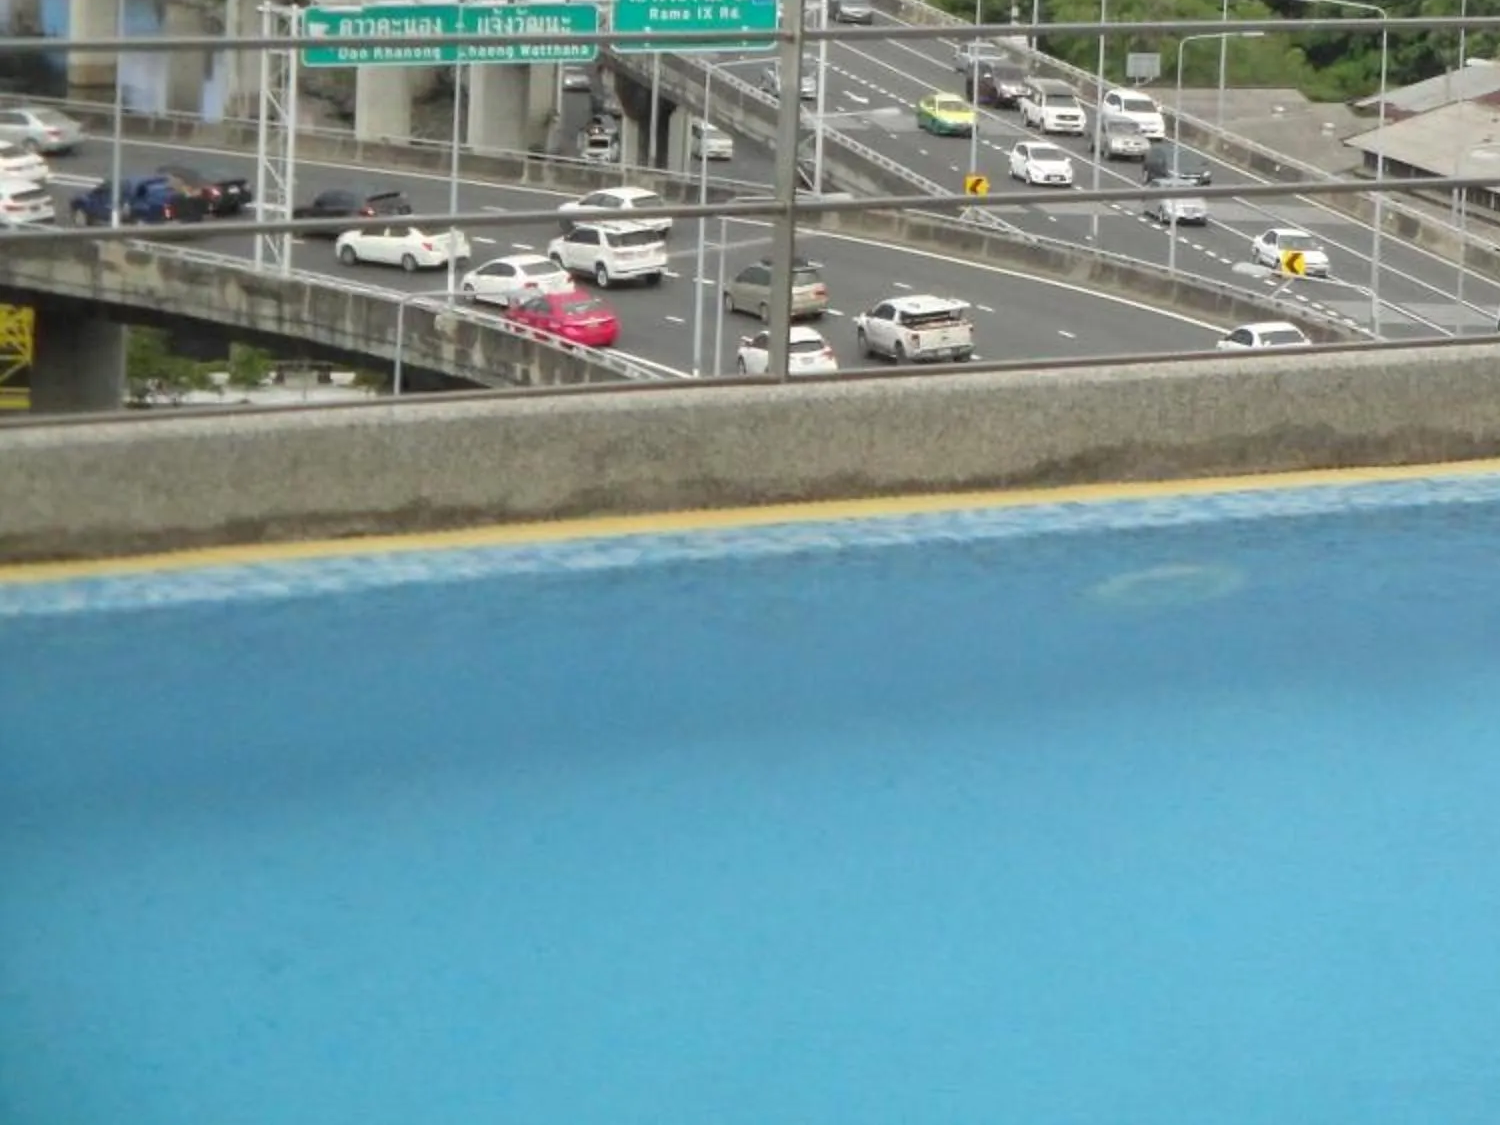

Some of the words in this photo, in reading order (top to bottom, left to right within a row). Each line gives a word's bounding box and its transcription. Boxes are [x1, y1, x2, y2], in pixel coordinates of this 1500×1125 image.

[650, 8, 691, 21] Rama
[697, 8, 713, 20] IX
[337, 46, 368, 60] Dao
